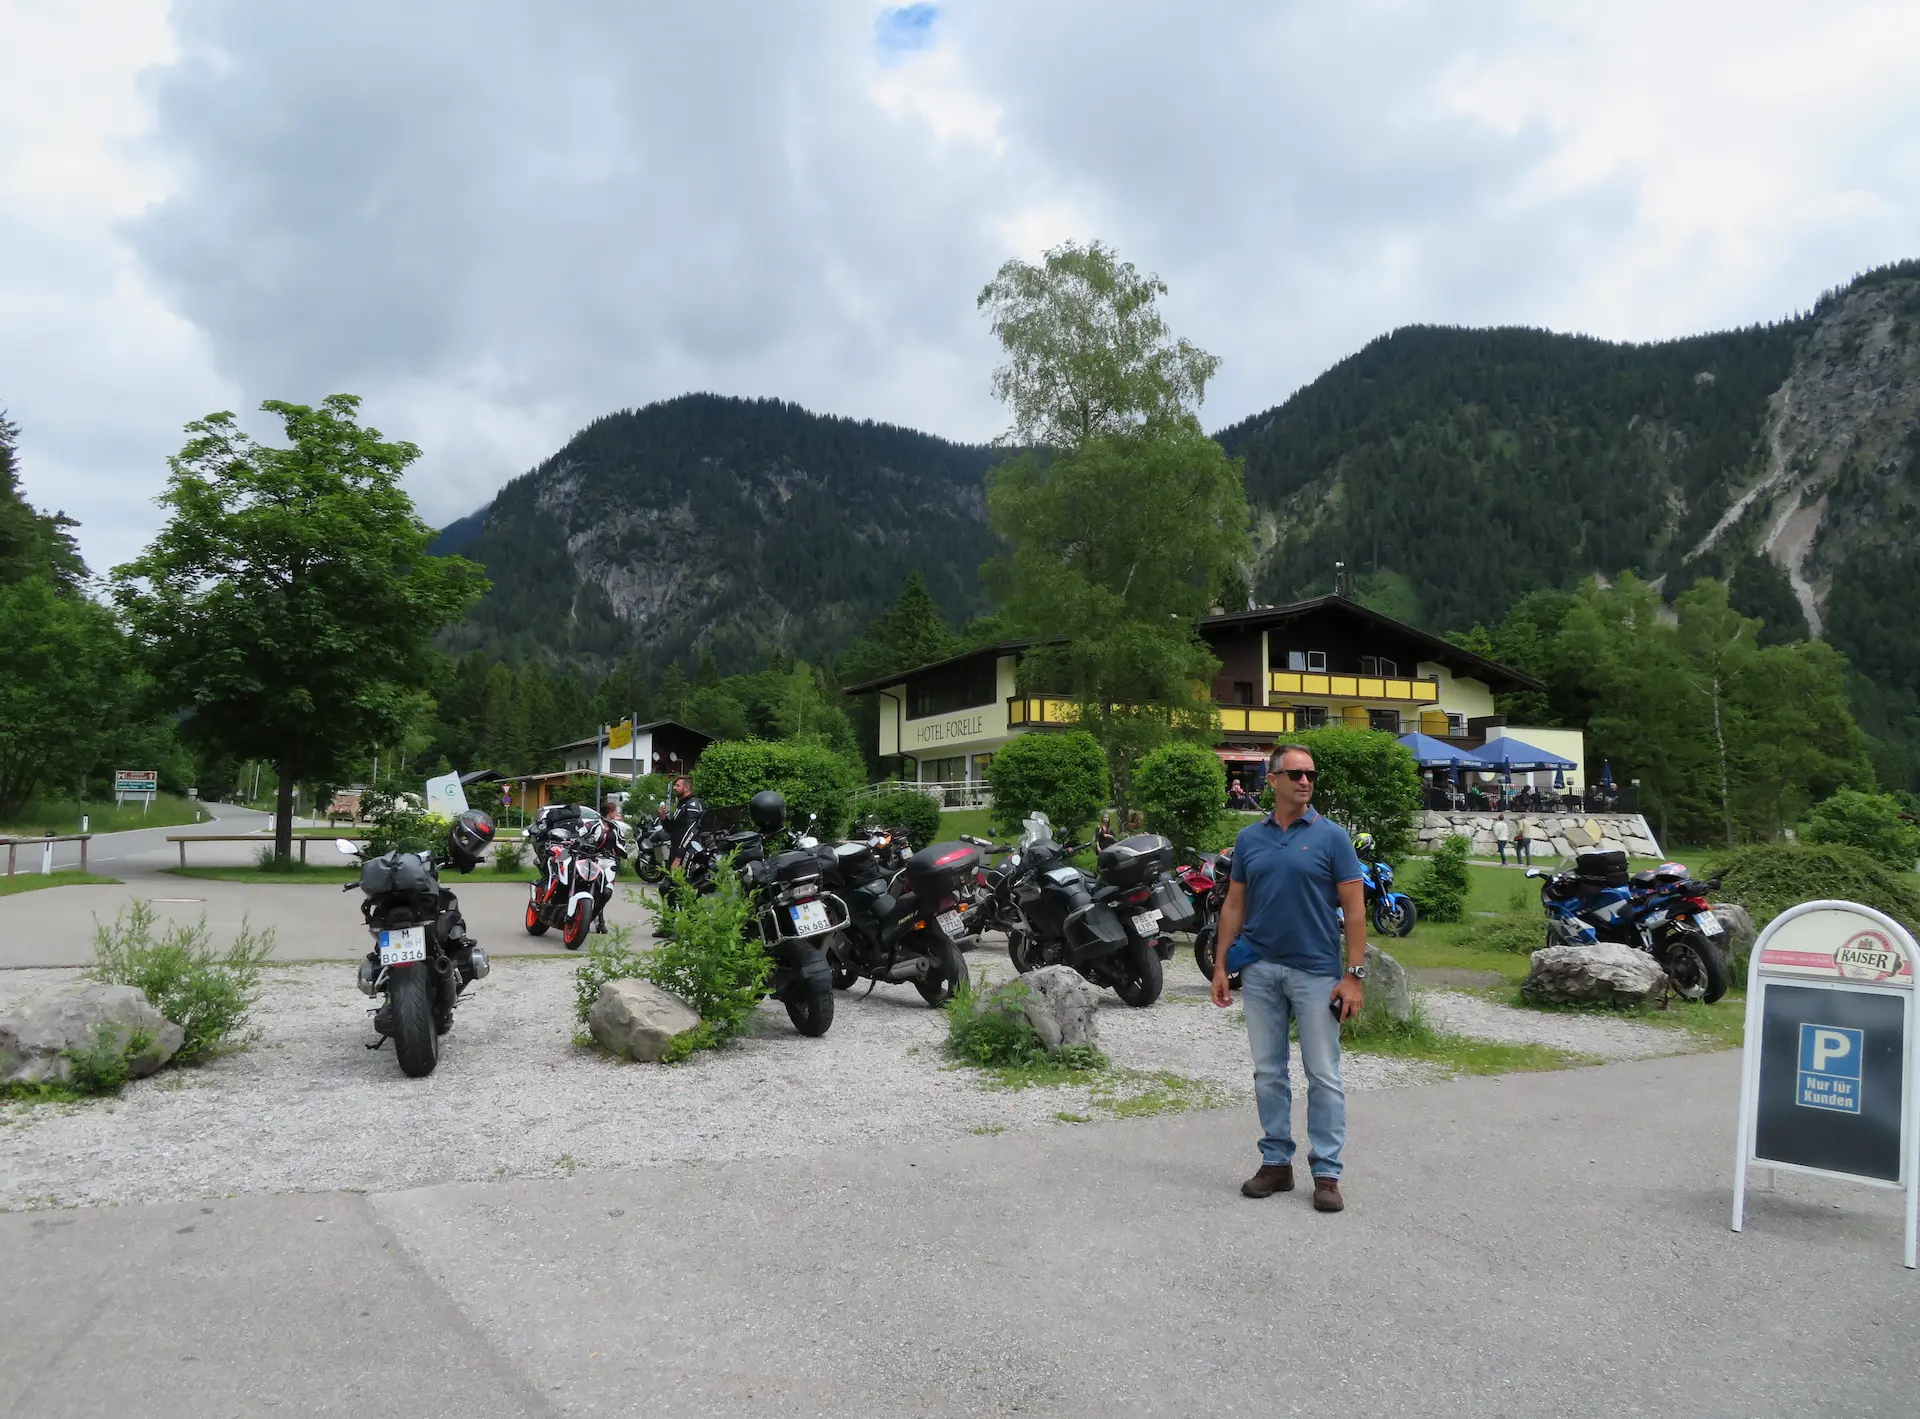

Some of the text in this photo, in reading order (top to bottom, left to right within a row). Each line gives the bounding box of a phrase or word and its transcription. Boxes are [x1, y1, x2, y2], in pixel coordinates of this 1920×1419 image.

[917, 716, 983, 743] HOTEL FORELLE
[402, 930, 409, 939] M
[798, 919, 830, 934] SN 681
[382, 950, 423, 964] BO 316
[1841, 949, 1888, 969] KAISER
[1813, 1029, 1851, 1071] P
[1806, 1076, 1852, 1093] Nur für
[1804, 1089, 1853, 1108] Kunden
